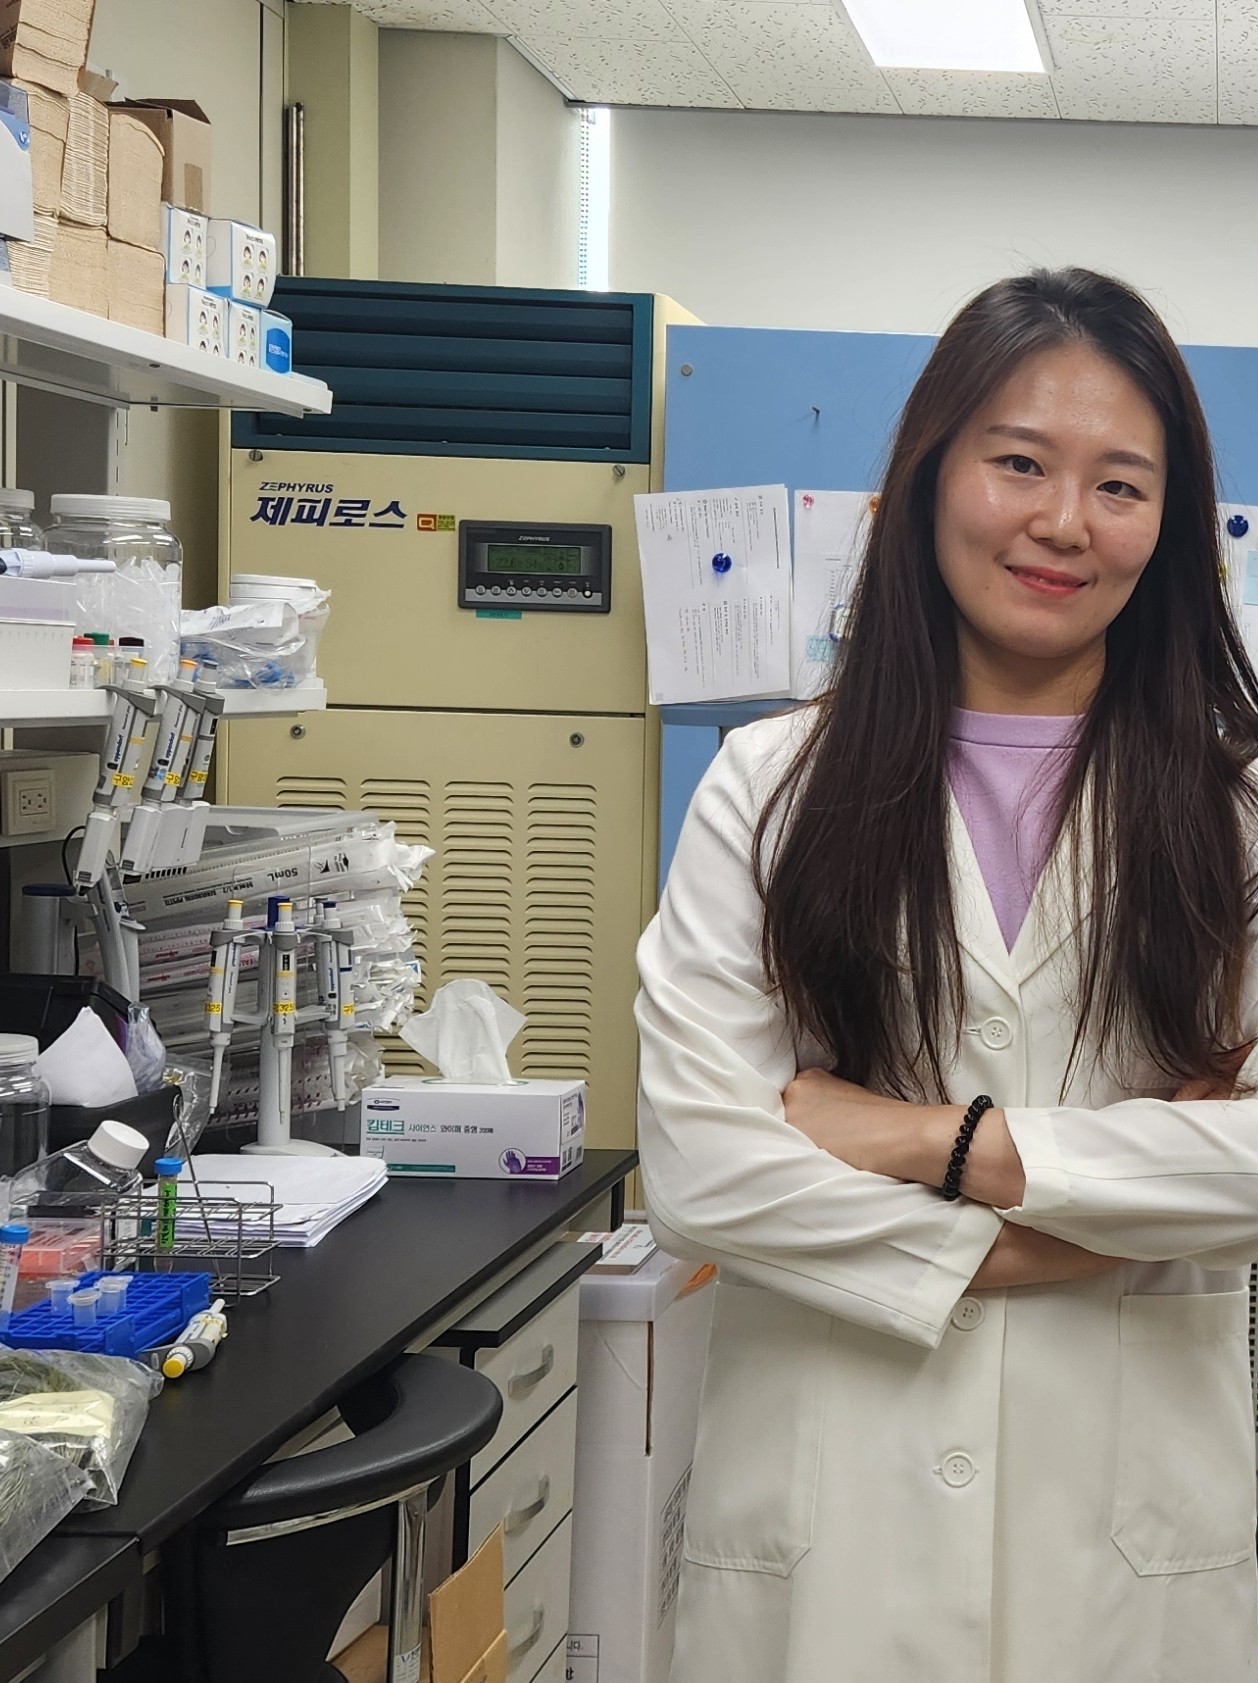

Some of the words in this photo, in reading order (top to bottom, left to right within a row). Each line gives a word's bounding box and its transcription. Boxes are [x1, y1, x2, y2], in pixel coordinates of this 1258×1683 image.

[258, 481, 334, 494] ZEPHYRUS
[249, 496, 407, 528] 제피로스
[267, 867, 298, 882] 50mL
[366, 1119, 404, 1132] 킴테크
[408, 1122, 437, 1133] 사이언스
